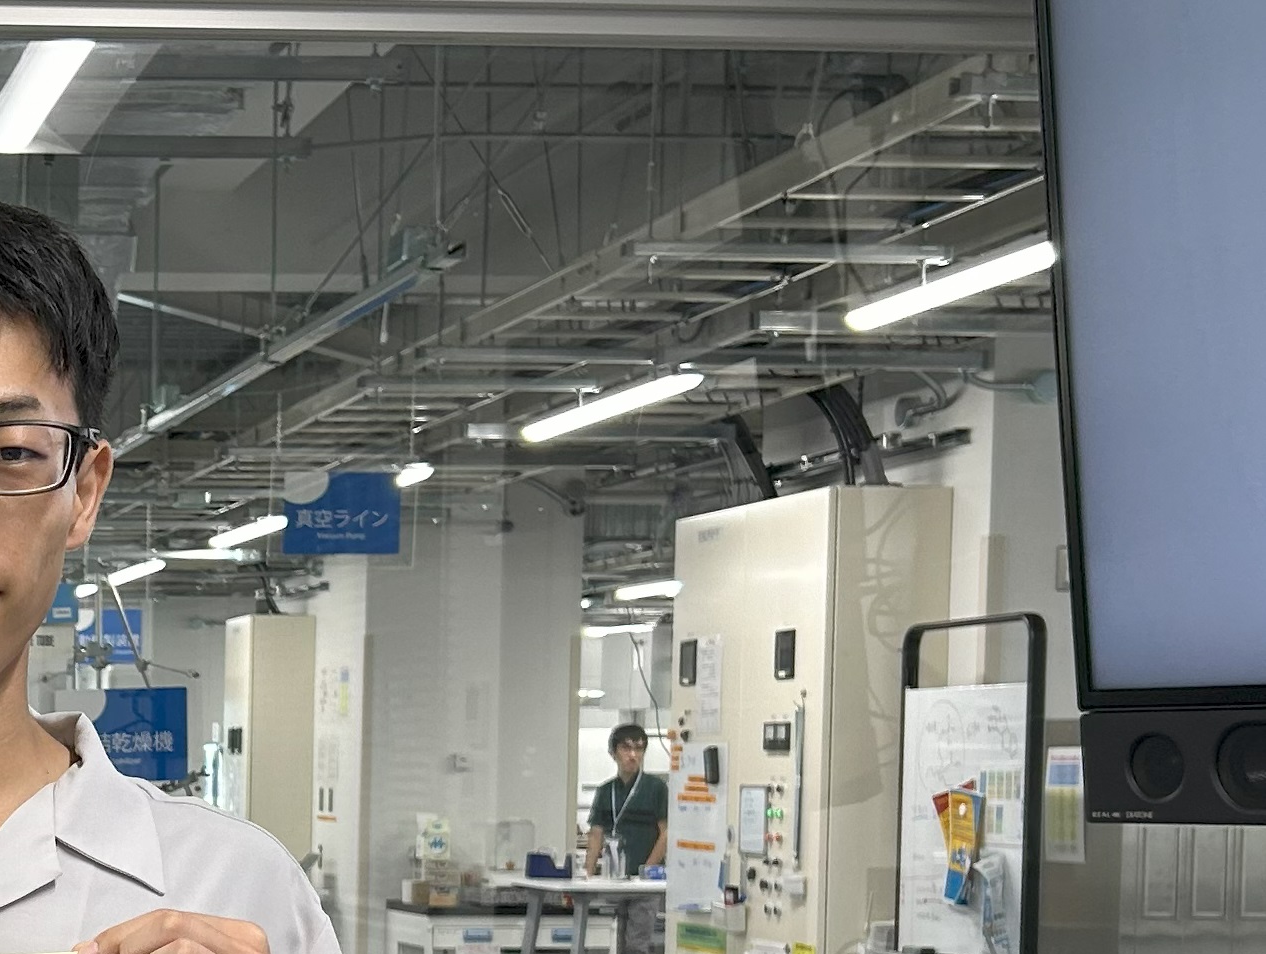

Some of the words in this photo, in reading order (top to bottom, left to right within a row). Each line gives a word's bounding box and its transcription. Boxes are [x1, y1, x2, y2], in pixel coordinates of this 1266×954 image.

[296, 508, 388, 529] 真空ライン
